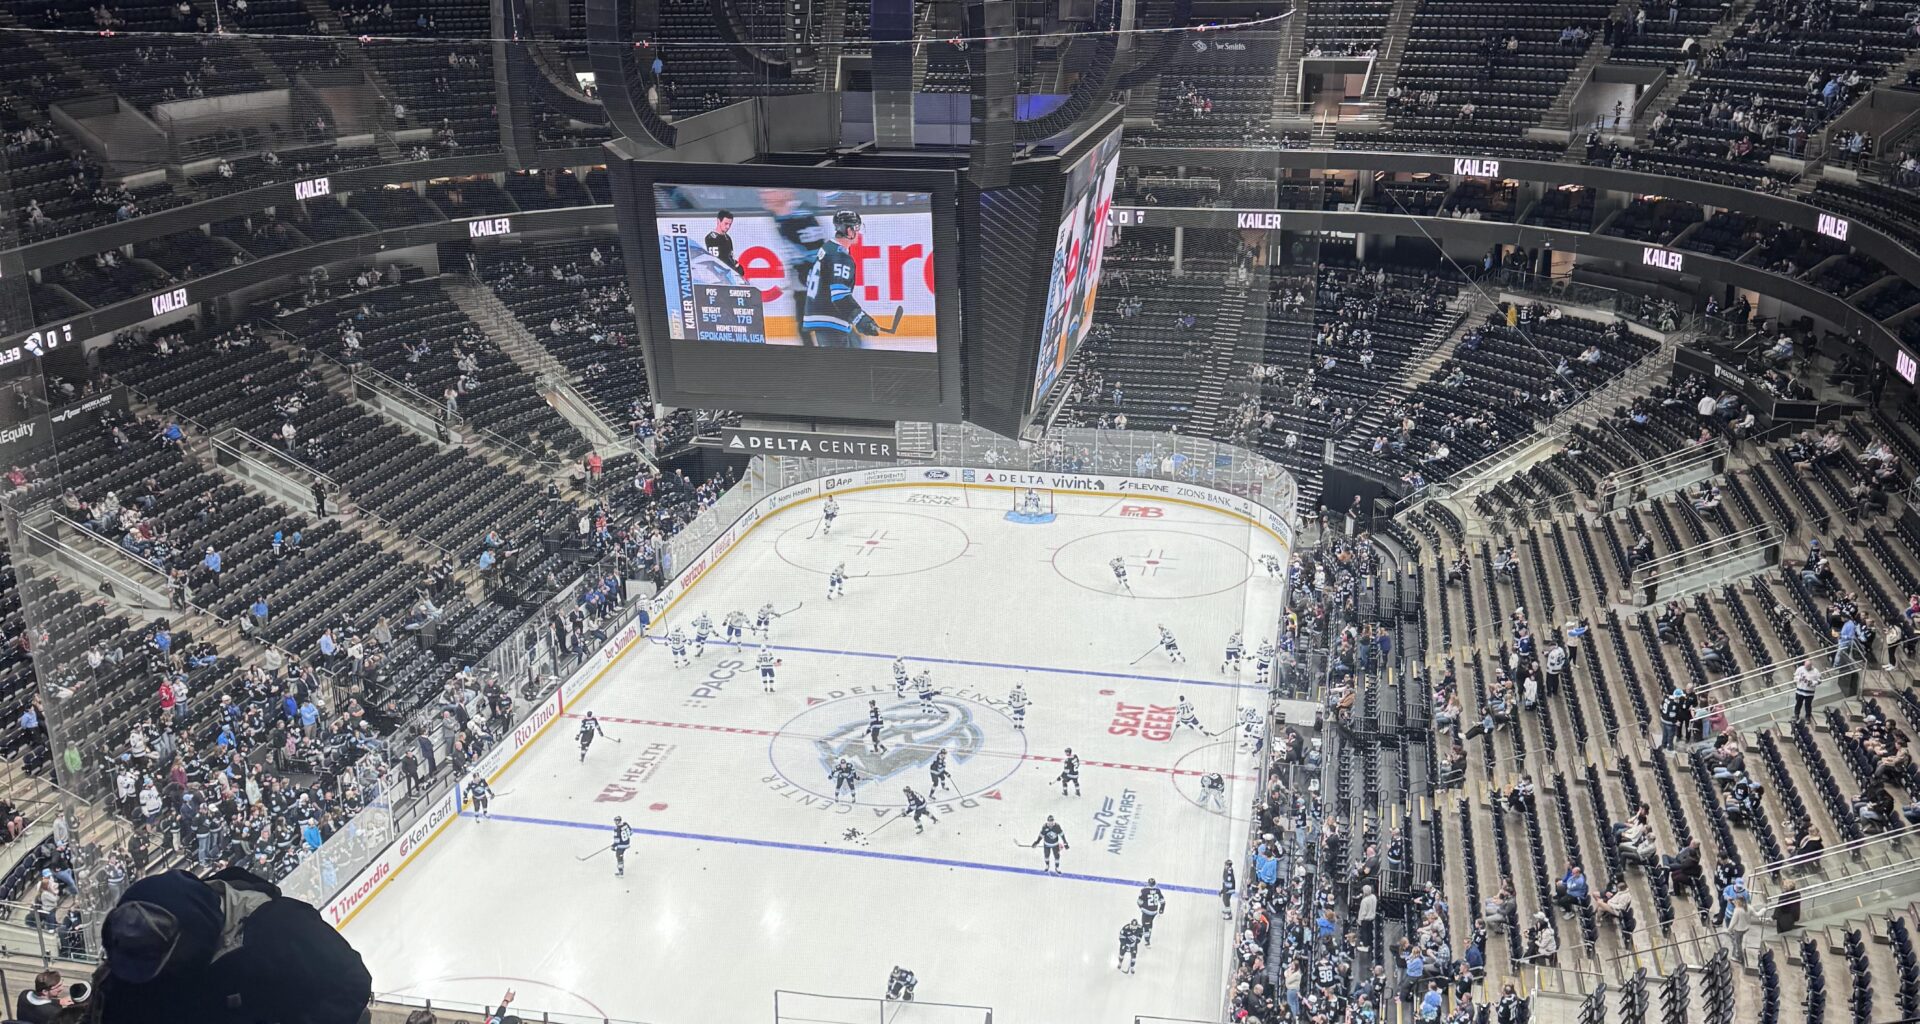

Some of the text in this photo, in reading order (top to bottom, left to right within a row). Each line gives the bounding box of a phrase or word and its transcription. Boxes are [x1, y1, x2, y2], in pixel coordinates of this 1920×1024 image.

[1453, 158, 1499, 178] KAILER
[294, 177, 330, 200] KAILER
[468, 217, 511, 238] KAILER
[1119, 211, 1128, 225] 0
[1237, 213, 1282, 230] KAILER
[1817, 213, 1849, 242] KAILER
[671, 224, 687, 234] 56
[1643, 247, 1683, 272] KAILER
[833, 263, 850, 279] 56
[676, 236, 696, 329] KAILER YAMAMOTO
[151, 287, 188, 317] KAILER
[706, 288, 751, 298] POS SHOOTS
[709, 296, 745, 306] F R
[733, 308, 754, 316] WEIGHT
[737, 315, 753, 324] 178
[716, 324, 747, 333] HOMETOWN
[750, 334, 765, 343] USA
[46, 330, 58, 349] 0
[1896, 349, 1918, 385] KAILER
[81, 394, 113, 411] AMERICA FIRST
[0, 422, 36, 444] Equity
[750, 436, 890, 456] DELTA CENTER
[1000, 474, 1044, 485] DELTA
[1128, 482, 1169, 493] FILEVINE
[792, 485, 812, 499] Health
[906, 497, 953, 505] BANK
[1176, 487, 1232, 507] ZIONS BANK
[680, 559, 707, 590] verizon
[691, 659, 744, 699] PACS
[1108, 701, 1145, 737] SEAT
[1141, 703, 1178, 743] GEEK
[619, 743, 668, 783] HEALTH
[408, 823, 430, 850] Ken
[428, 796, 454, 829] Garff
[1107, 788, 1137, 855] AMERICA FIRST
[338, 862, 391, 914] Trucordia
[1319, 969, 1334, 983] 98
